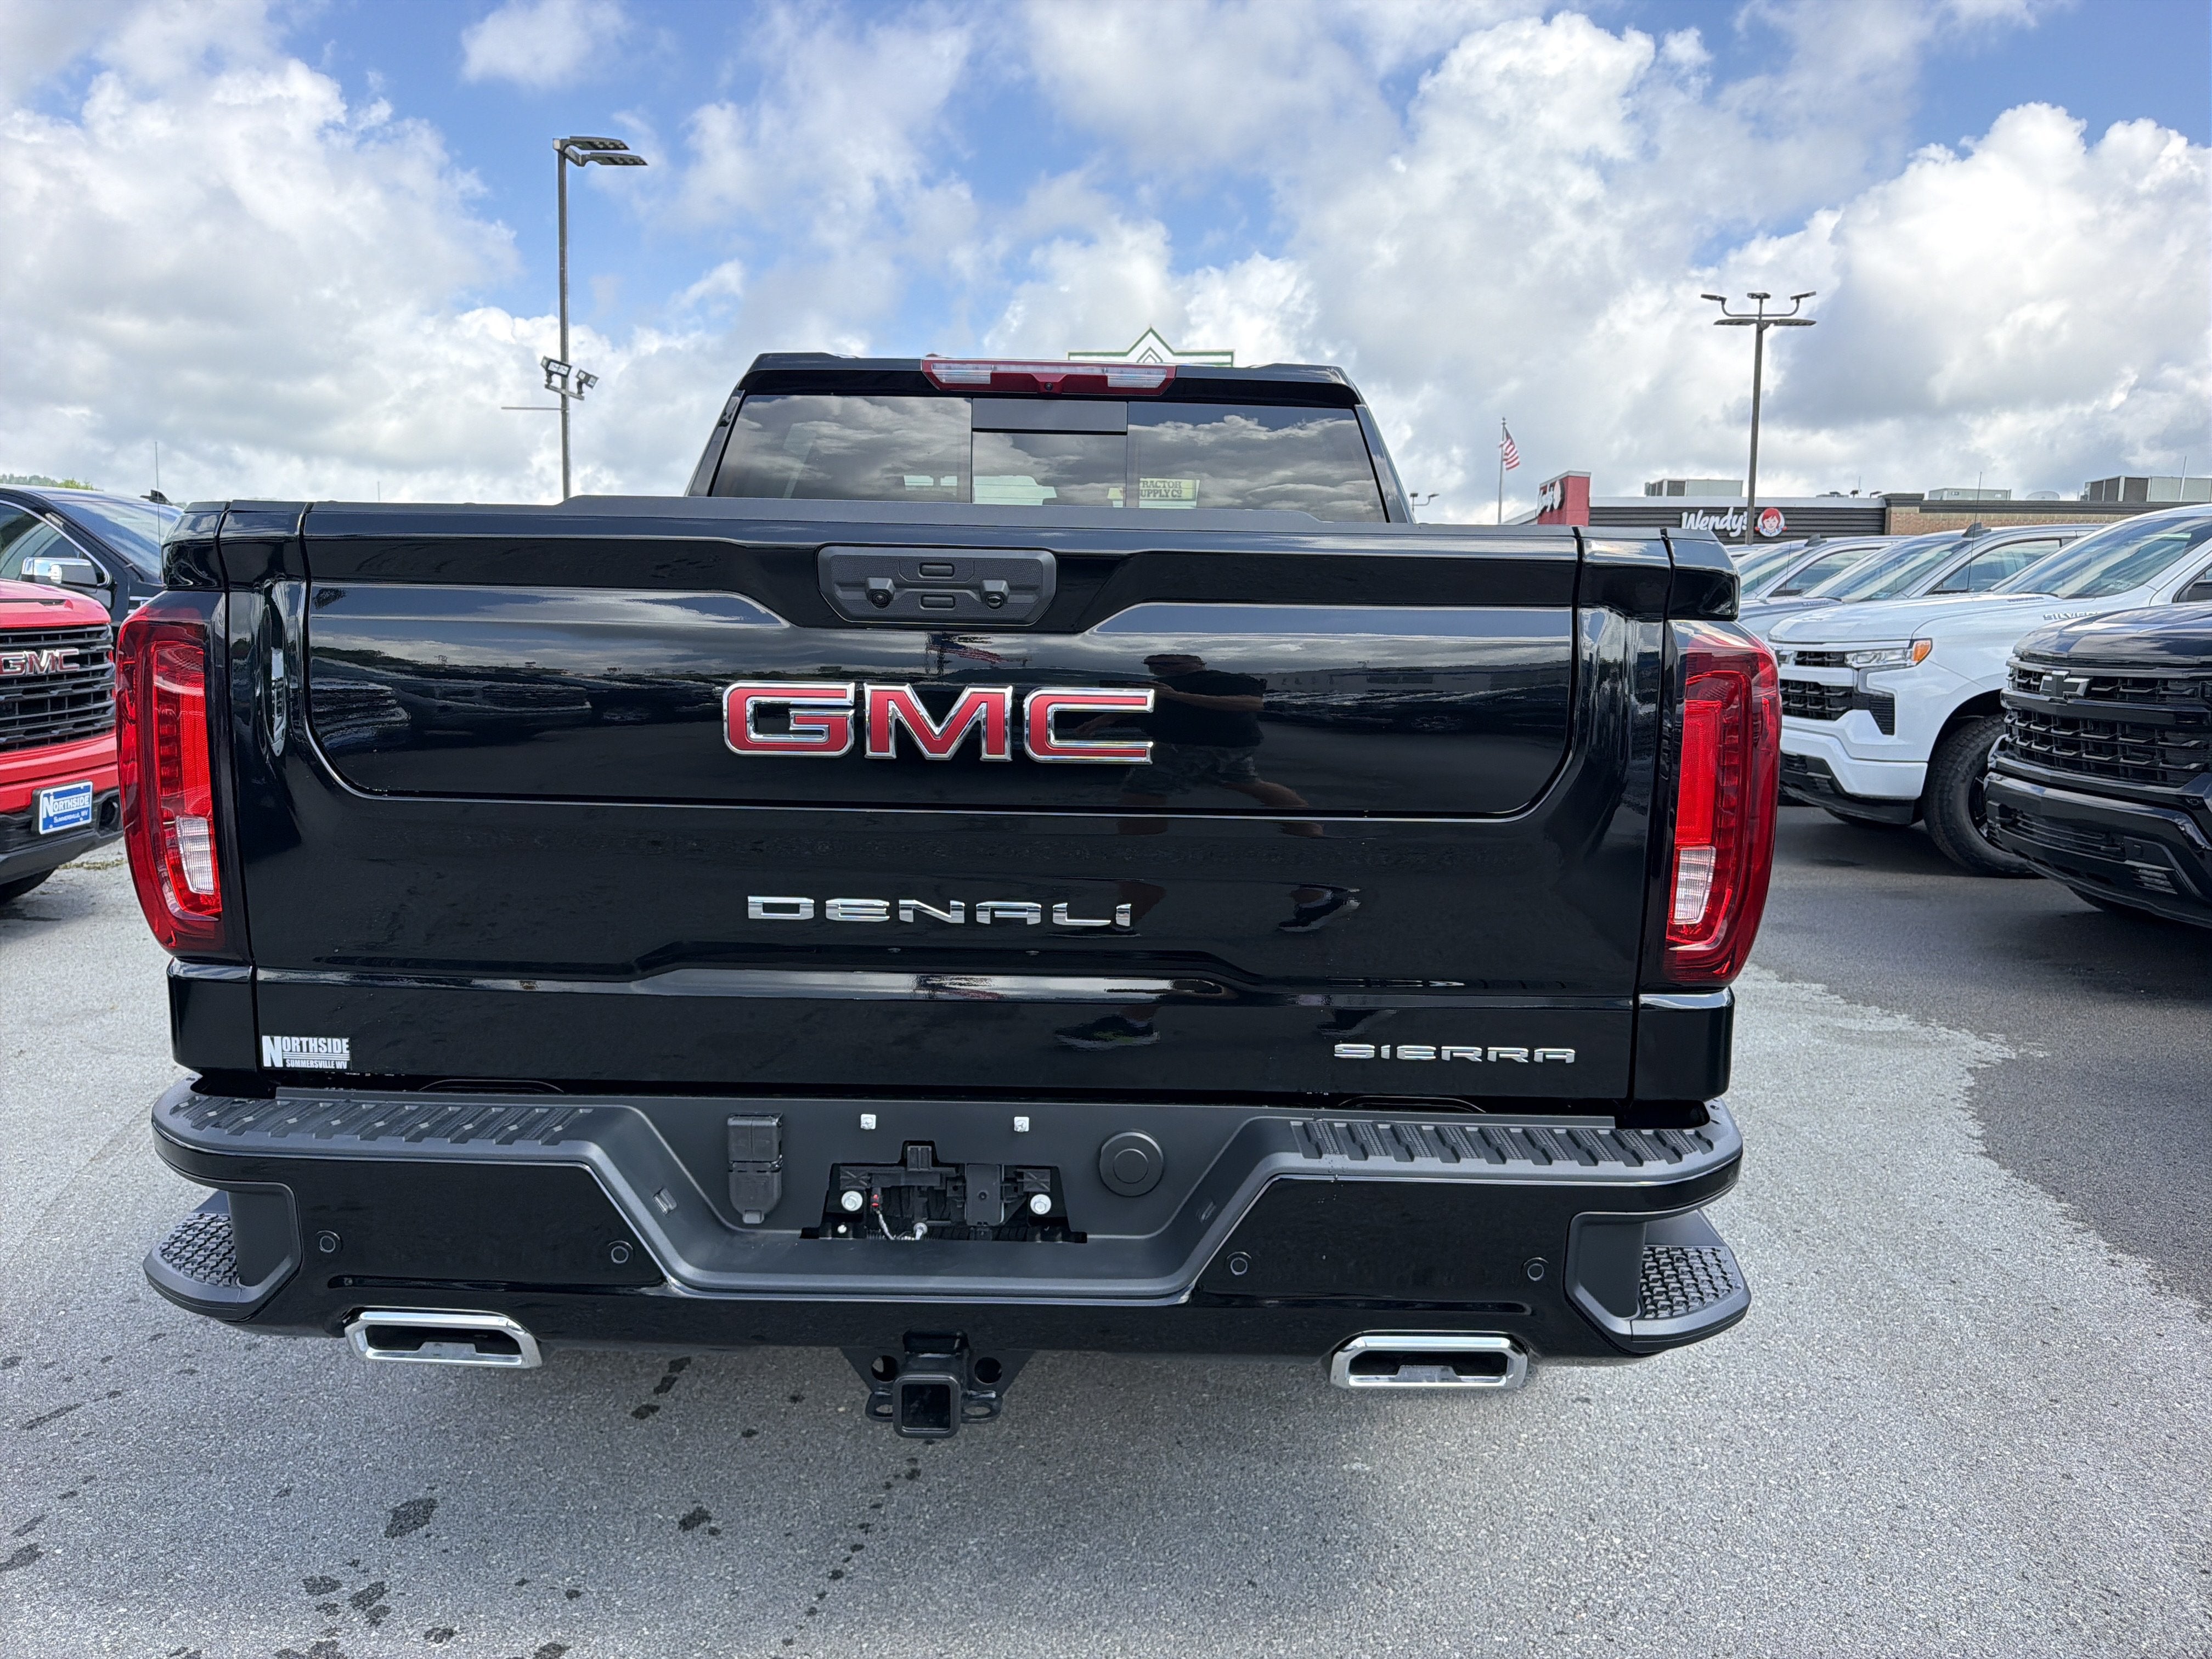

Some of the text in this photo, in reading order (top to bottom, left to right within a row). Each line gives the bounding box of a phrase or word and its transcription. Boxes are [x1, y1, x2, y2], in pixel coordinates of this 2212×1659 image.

[1141, 480, 1182, 488] RACTOR
[1141, 489, 1170, 498] UPPLY
[1681, 506, 1747, 537] Wendy's
[0, 648, 80, 676] GMC
[723, 680, 1155, 764] GMC
[43, 794, 89, 819] NORTHSIDE
[747, 896, 1132, 927] DENALI
[262, 1035, 350, 1068] NORTHSIDE
[286, 1059, 347, 1069] SUMMERSVILLE WV
[1334, 1043, 1576, 1063] SIERRA
